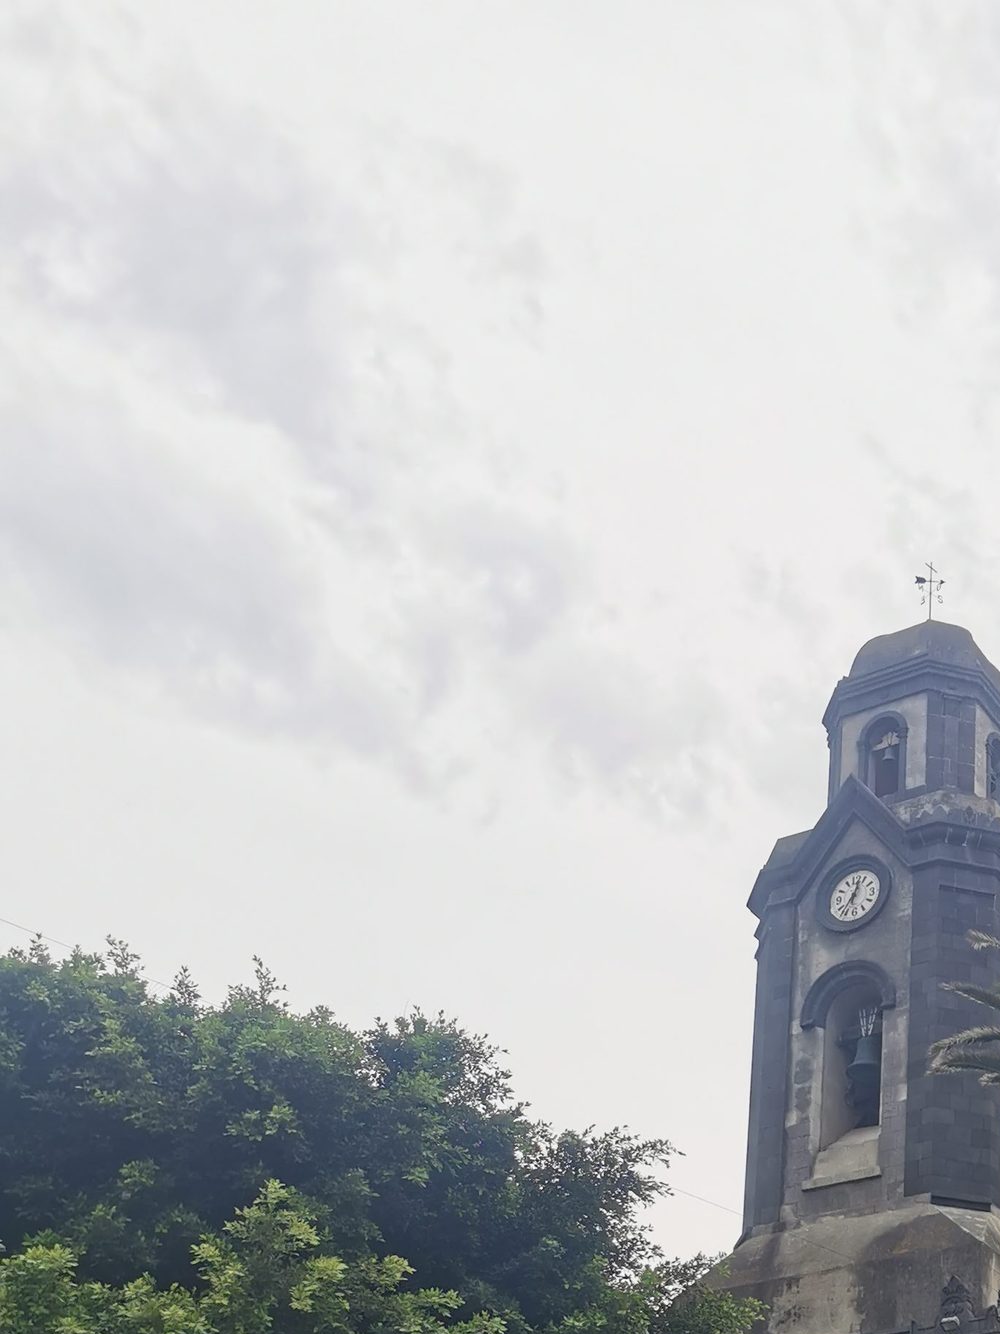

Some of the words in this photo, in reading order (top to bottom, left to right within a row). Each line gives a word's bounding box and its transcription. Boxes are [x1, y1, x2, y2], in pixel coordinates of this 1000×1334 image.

[852, 875, 861, 885] 12
[869, 887, 875, 896] 3
[836, 896, 842, 905] 9
